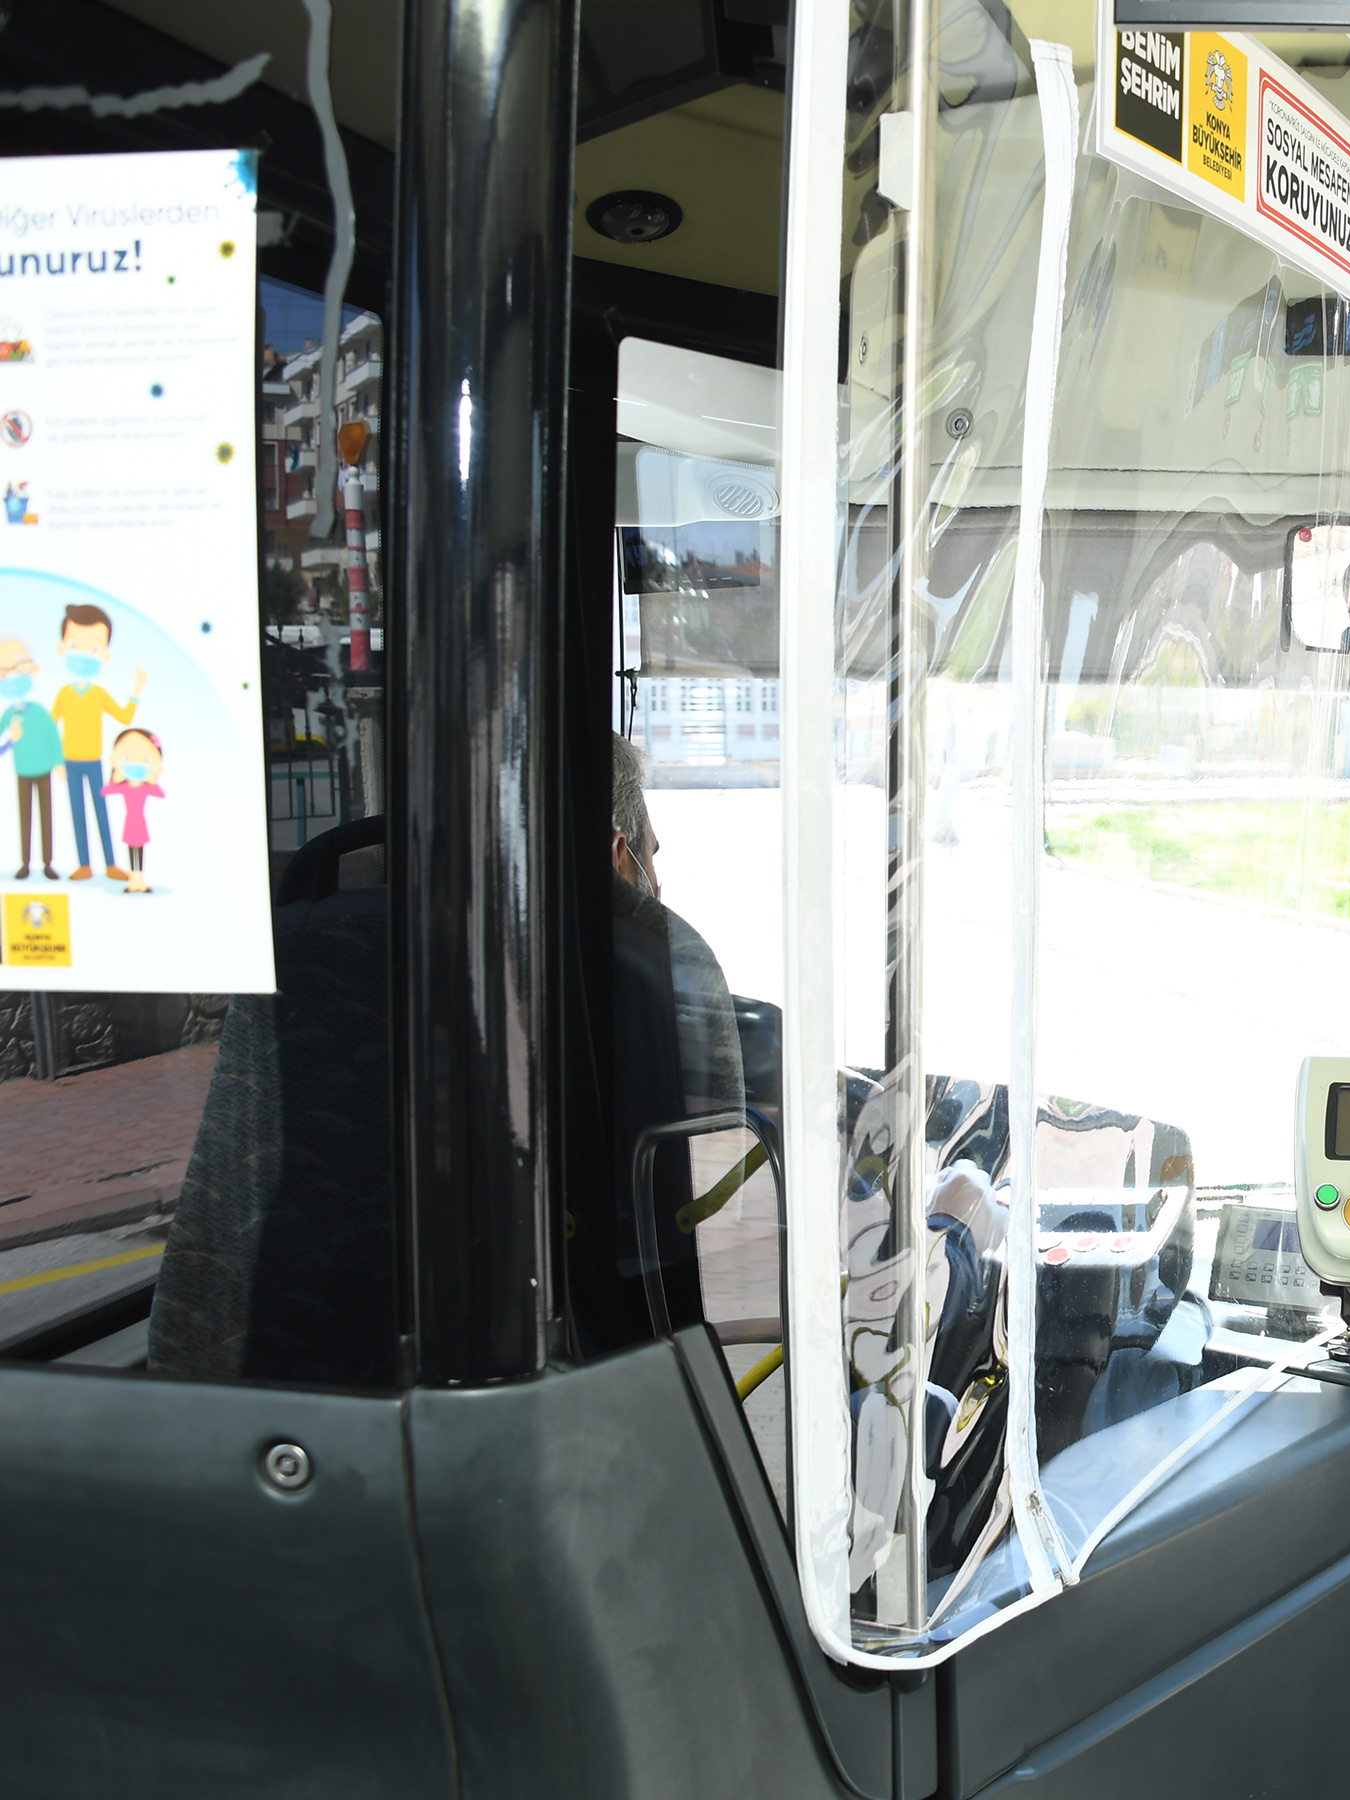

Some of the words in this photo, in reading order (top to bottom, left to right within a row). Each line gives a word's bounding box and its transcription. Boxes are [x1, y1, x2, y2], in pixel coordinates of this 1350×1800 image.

[1120, 57, 1180, 120] ŞEHRİM
[1205, 111, 1231, 141] KONYA
[1266, 117, 1308, 173] SOSYAL
[1192, 123, 1242, 172] BÜYÜKŞEHİR
[1202, 153, 1233, 181] BELEDİYESİ
[66, 199, 220, 229] Virüslerden
